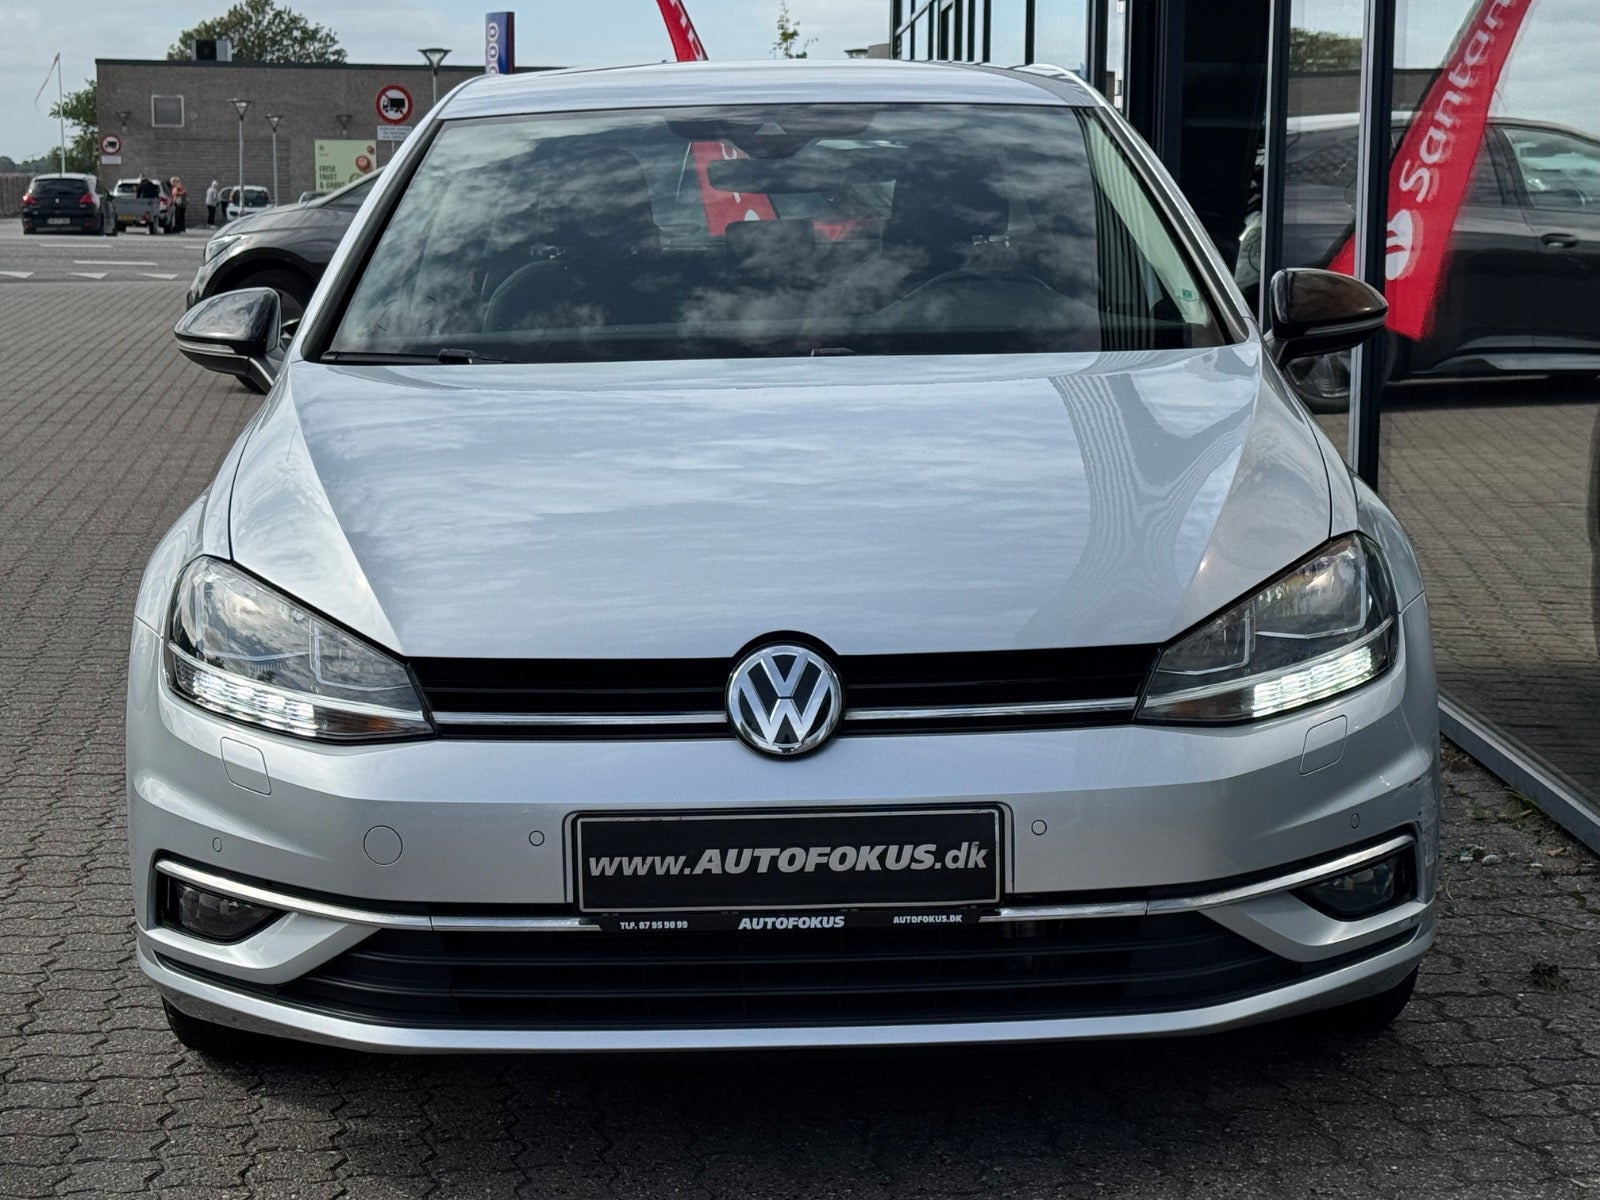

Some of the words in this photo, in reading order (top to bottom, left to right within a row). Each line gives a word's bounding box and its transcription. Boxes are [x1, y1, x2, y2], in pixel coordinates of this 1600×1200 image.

[588, 842, 988, 877] www.AUTOFOKUS.dk
[738, 915, 845, 930] AUTOFOKUS
[893, 914, 963, 924] AUTOFOKUS.DK
